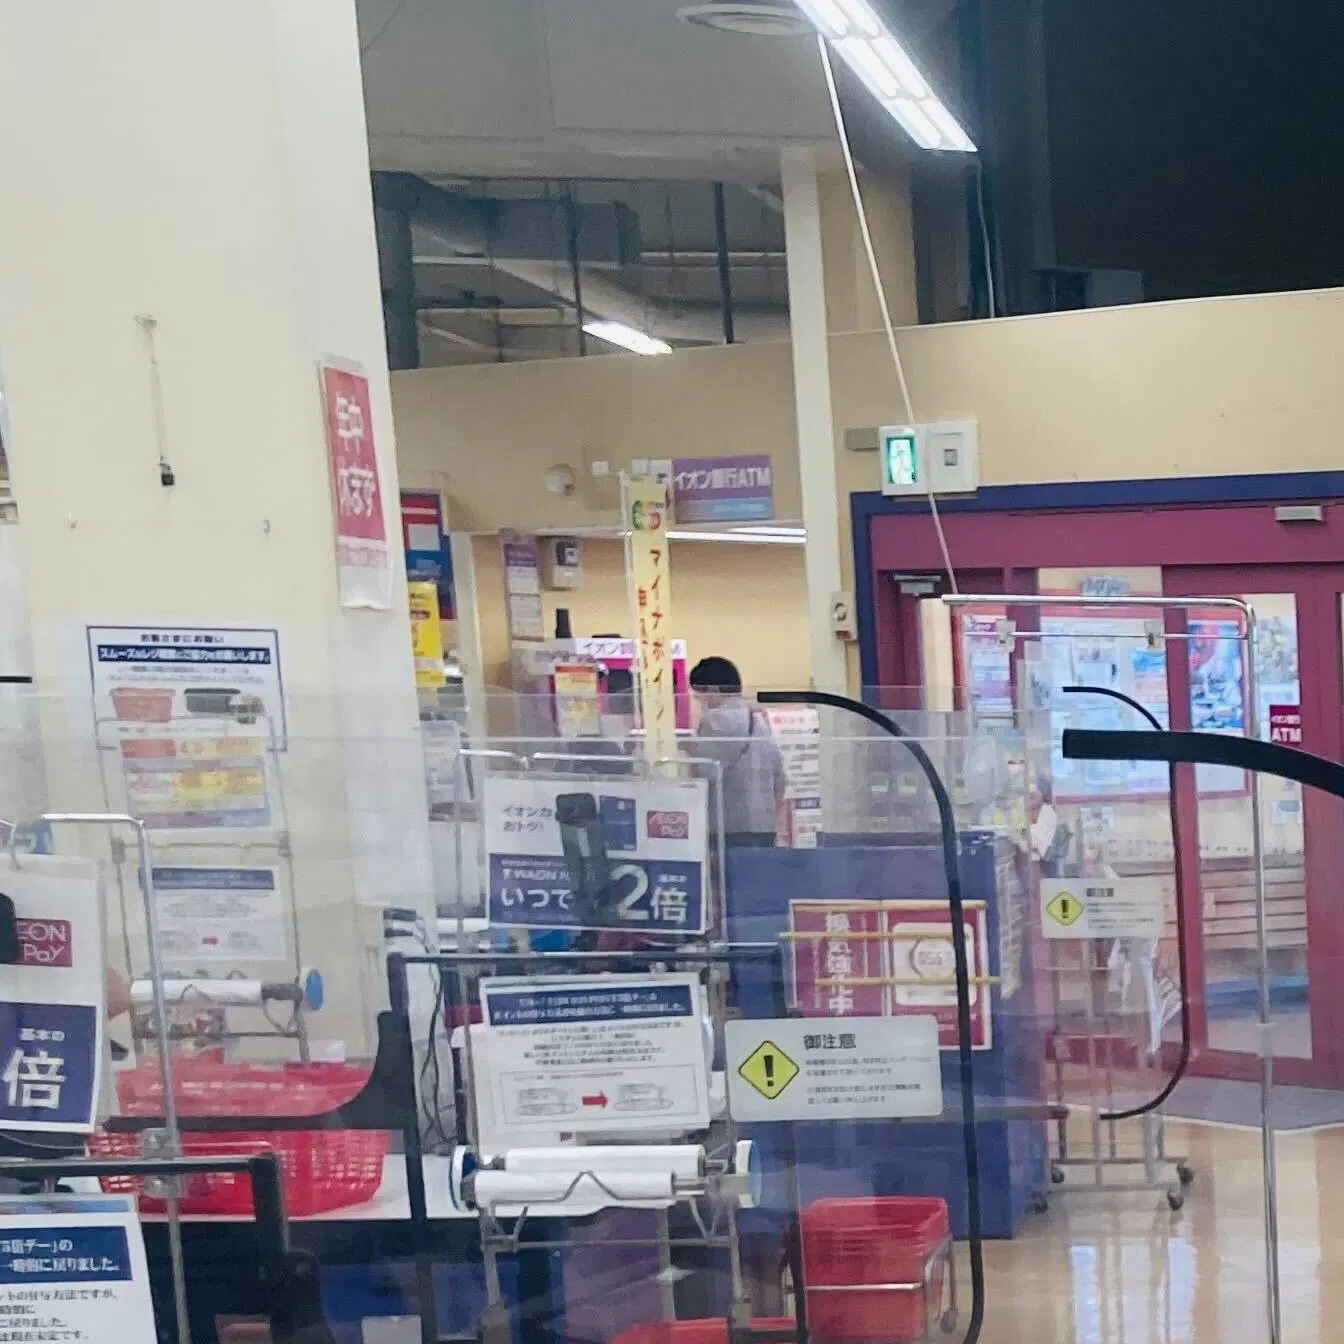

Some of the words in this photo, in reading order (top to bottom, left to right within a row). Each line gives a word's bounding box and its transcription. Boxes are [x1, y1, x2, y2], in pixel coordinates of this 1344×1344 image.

[1271, 727, 1301, 742] ATM
[651, 885, 688, 922] 倍
[23, 943, 65, 963] Pay
[803, 1033, 857, 1050] 御注意
[3, 1048, 67, 1110] 倍
